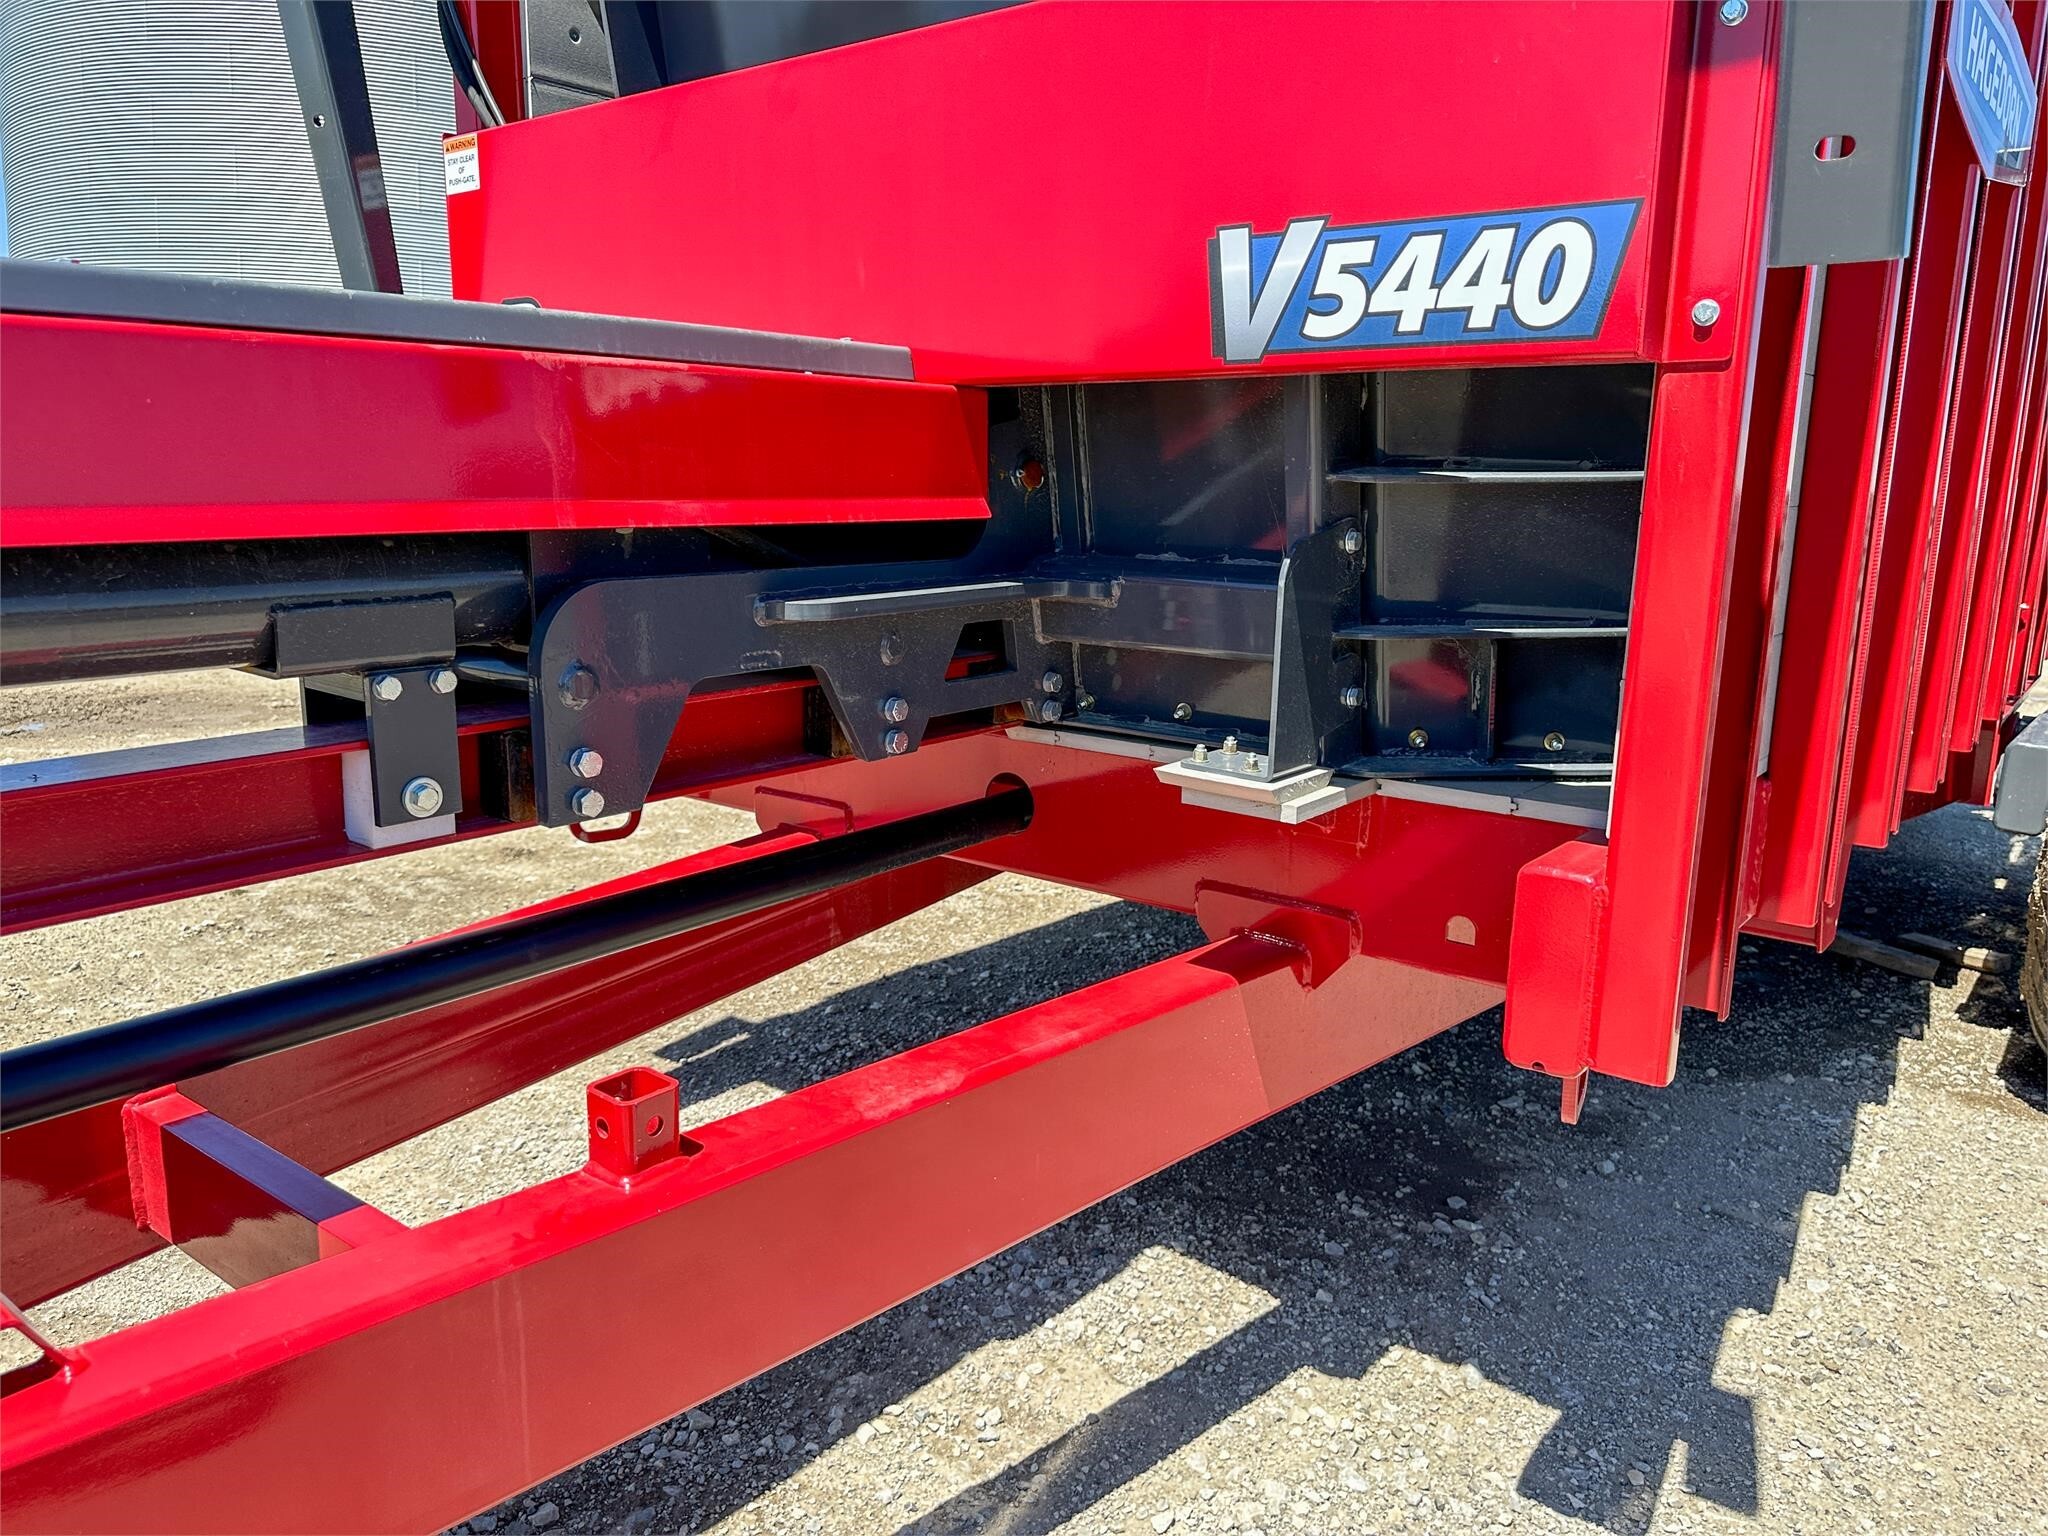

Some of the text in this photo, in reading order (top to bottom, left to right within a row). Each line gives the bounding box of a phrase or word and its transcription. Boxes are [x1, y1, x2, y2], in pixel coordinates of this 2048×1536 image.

[450, 138, 475, 150] WARNING
[447, 154, 474, 166] STAY CLEAR
[458, 166, 465, 174] OF
[1215, 217, 1598, 363] V5440
